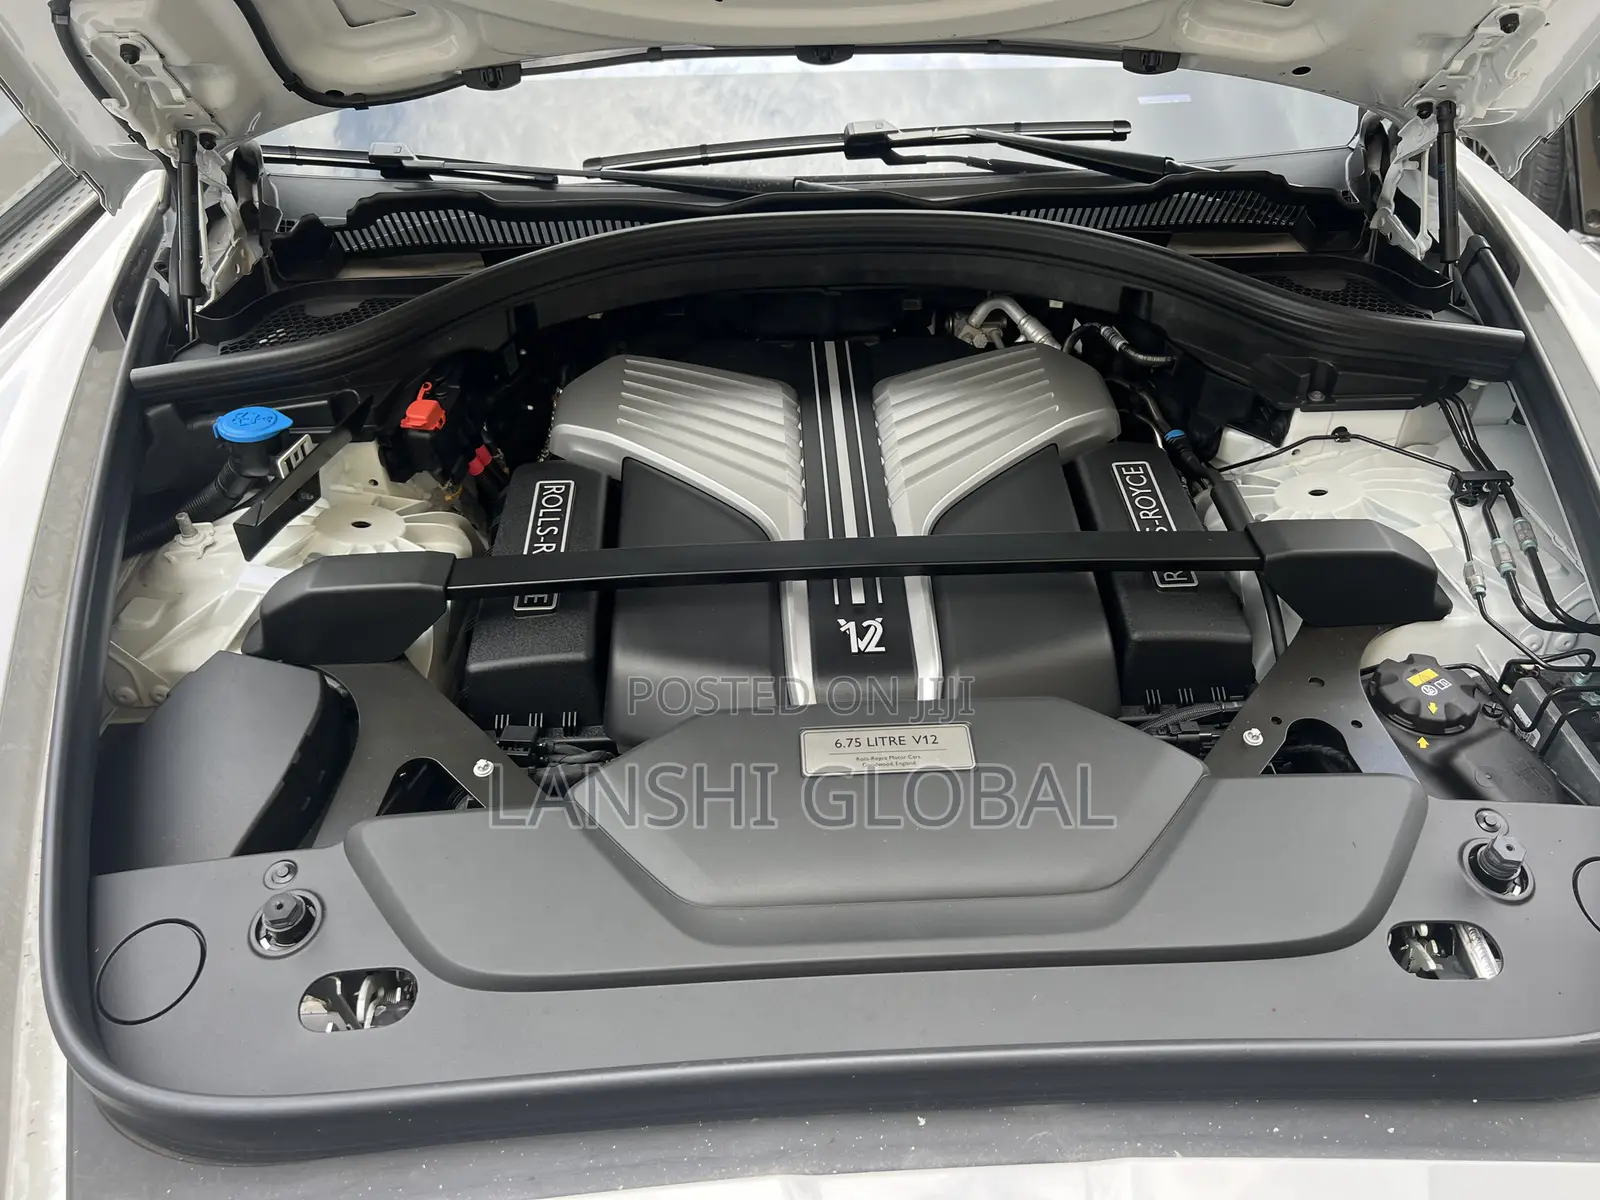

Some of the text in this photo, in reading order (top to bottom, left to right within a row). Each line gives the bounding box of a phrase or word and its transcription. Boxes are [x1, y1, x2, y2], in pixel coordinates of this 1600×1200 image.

[524, 484, 566, 604] ROLLS-RE
[1121, 466, 1188, 581] R-ROYCE
[834, 734, 939, 749] 6.75 LITRE V12
